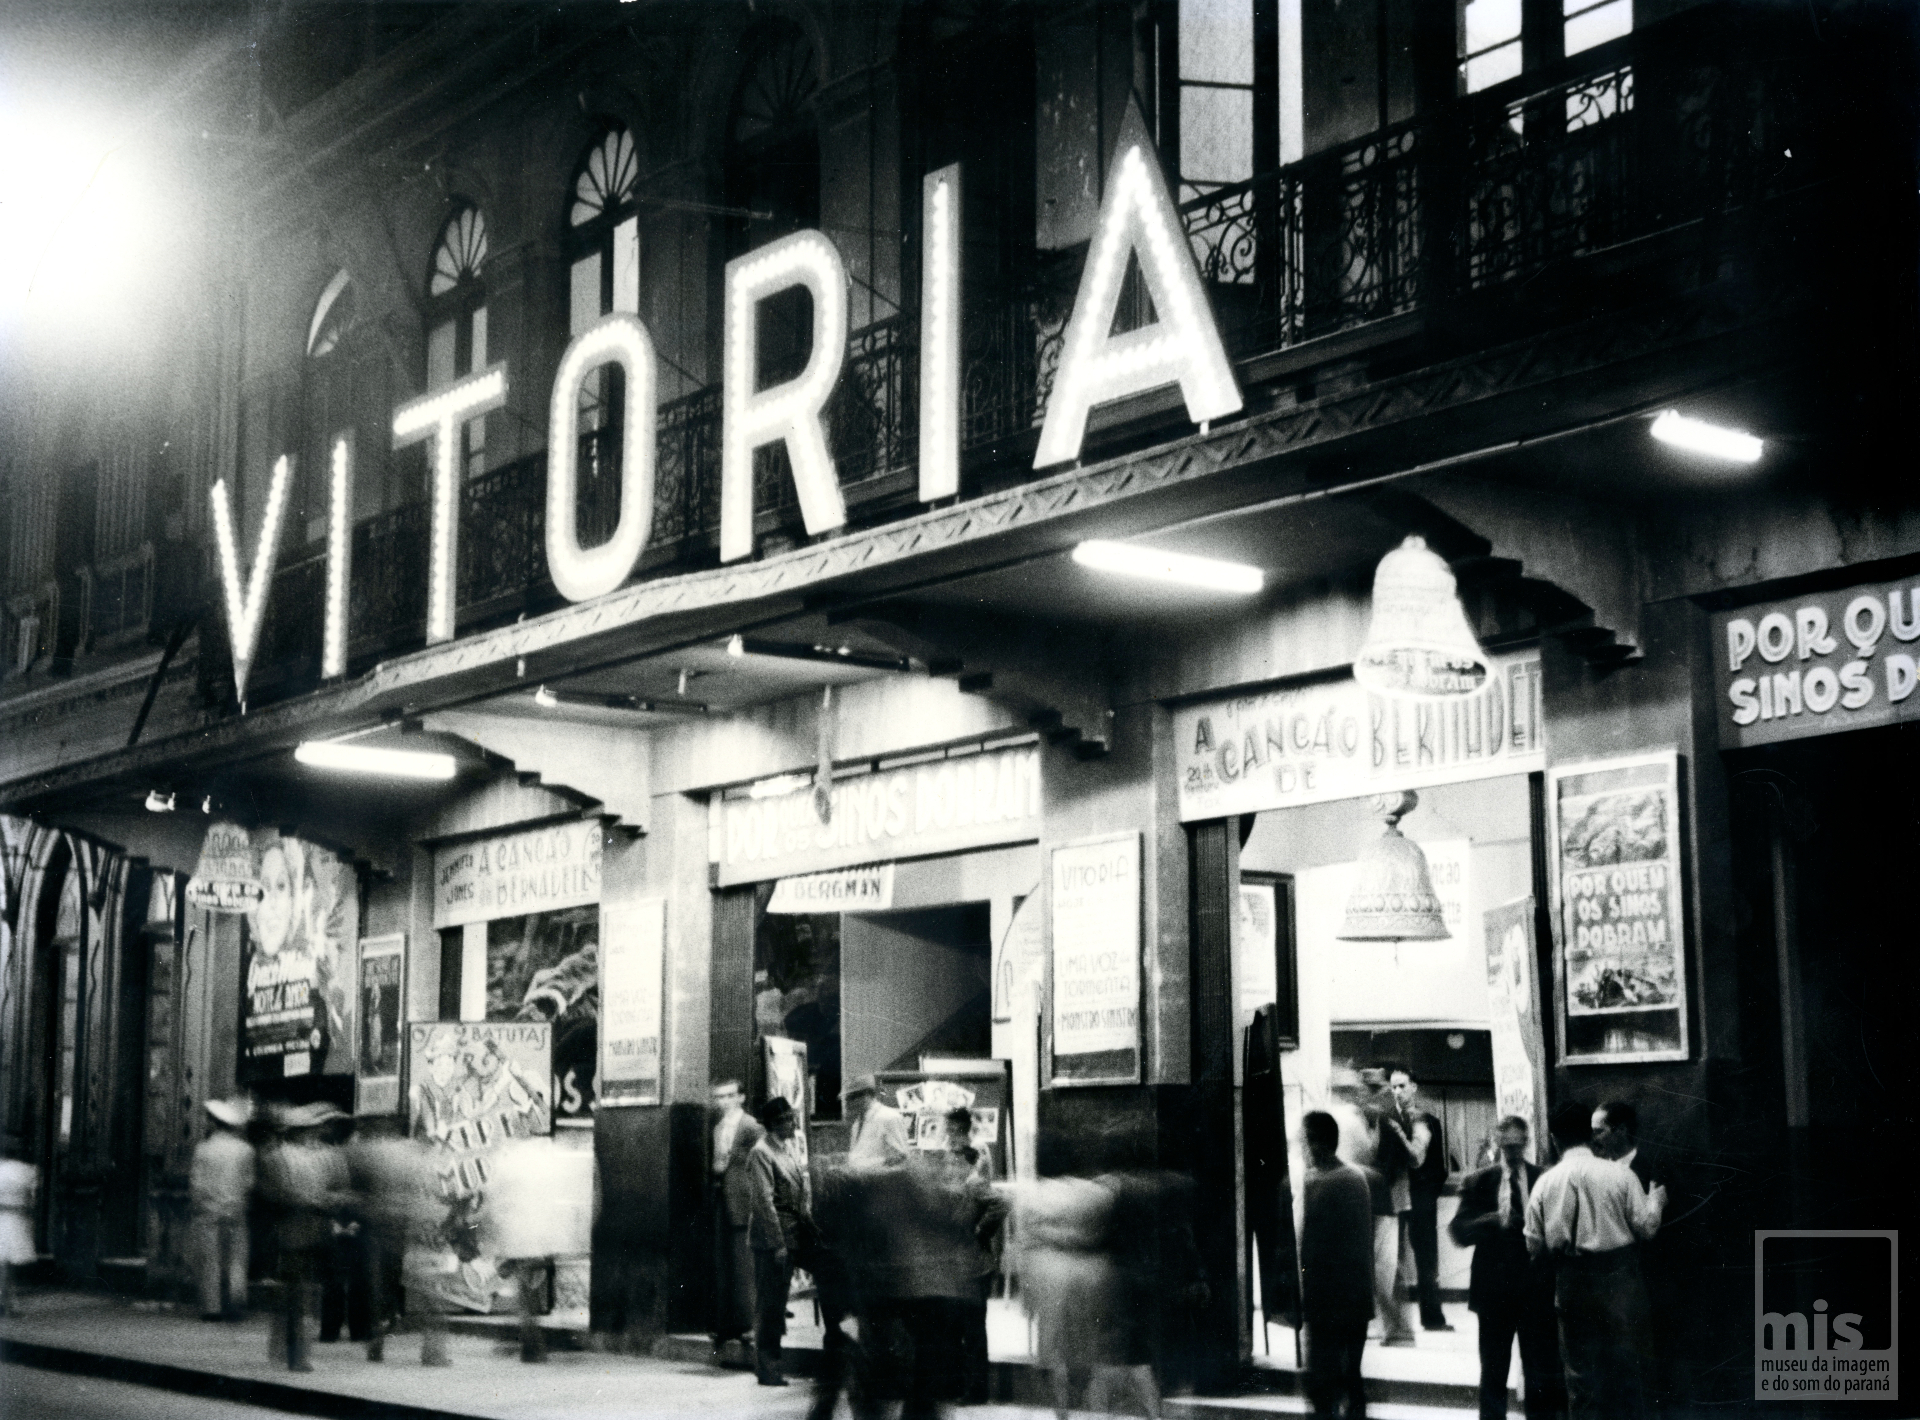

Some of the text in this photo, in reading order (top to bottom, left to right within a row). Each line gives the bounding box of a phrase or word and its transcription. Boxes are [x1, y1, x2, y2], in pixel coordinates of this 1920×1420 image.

[208, 92, 1244, 706] VITORIA
[1726, 606, 1838, 671] POR
[1728, 653, 1920, 726] SINOS D
[1193, 716, 1217, 756] A
[1273, 761, 1317, 795] DE
[726, 801, 779, 865] POR
[914, 751, 1039, 834] DOBRAM
[479, 841, 494, 878] A
[794, 877, 882, 901] BERGMAN
[1570, 865, 1665, 900] POR QUEM
[1577, 893, 1662, 921] OS SINOS
[1577, 920, 1667, 950] DOBRAM
[472, 1025, 549, 1051] BATUTAS
